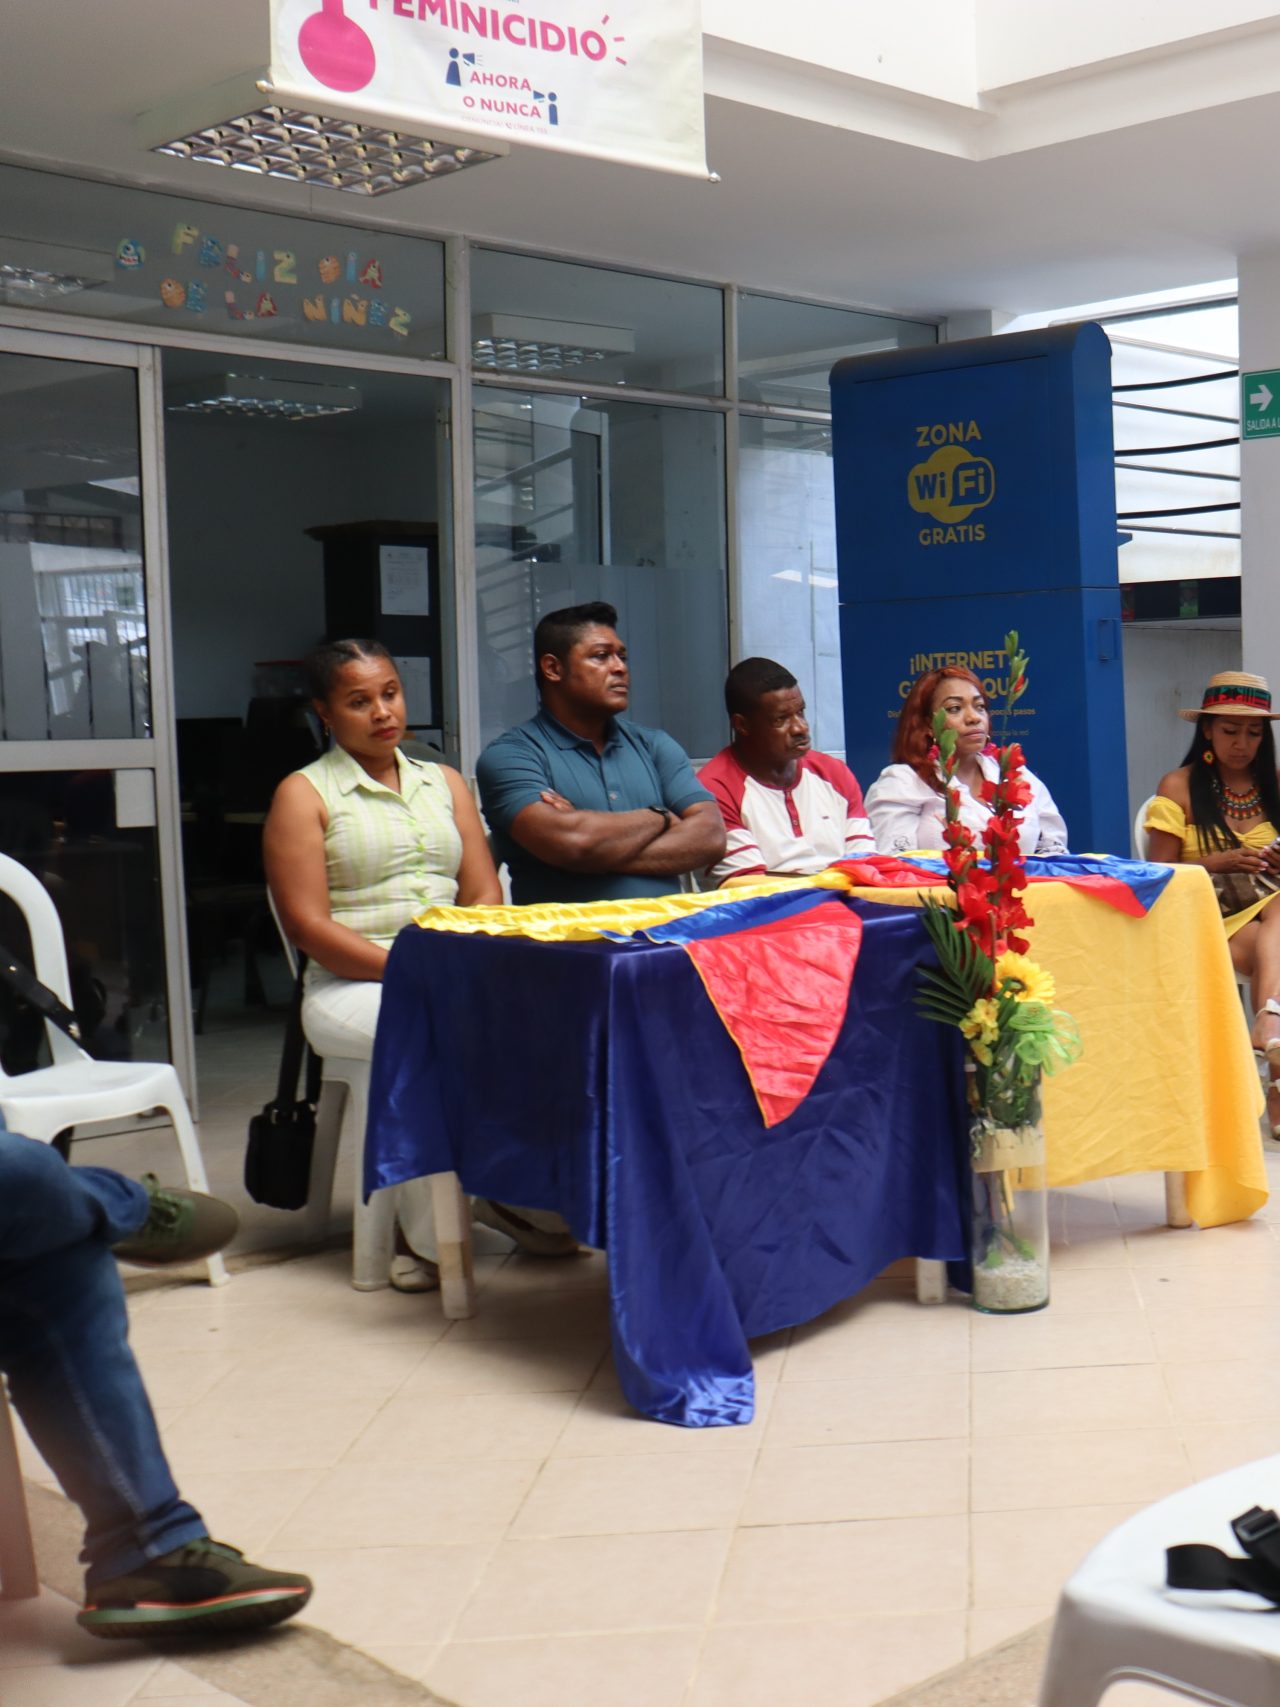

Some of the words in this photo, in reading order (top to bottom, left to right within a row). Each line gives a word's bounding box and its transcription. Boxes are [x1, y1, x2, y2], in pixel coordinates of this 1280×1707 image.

[470, 71, 532, 92] AHORA
[463, 96, 475, 108] O
[480, 98, 541, 118] NUNCA
[172, 223, 297, 284] FELIZ
[160, 277, 206, 314] DE
[225, 290, 278, 319] LA
[303, 293, 411, 336] NIÑEZ
[916, 420, 982, 447] ZONA
[1247, 418, 1271, 431] SALIDA
[919, 525, 985, 546] GRATIS
